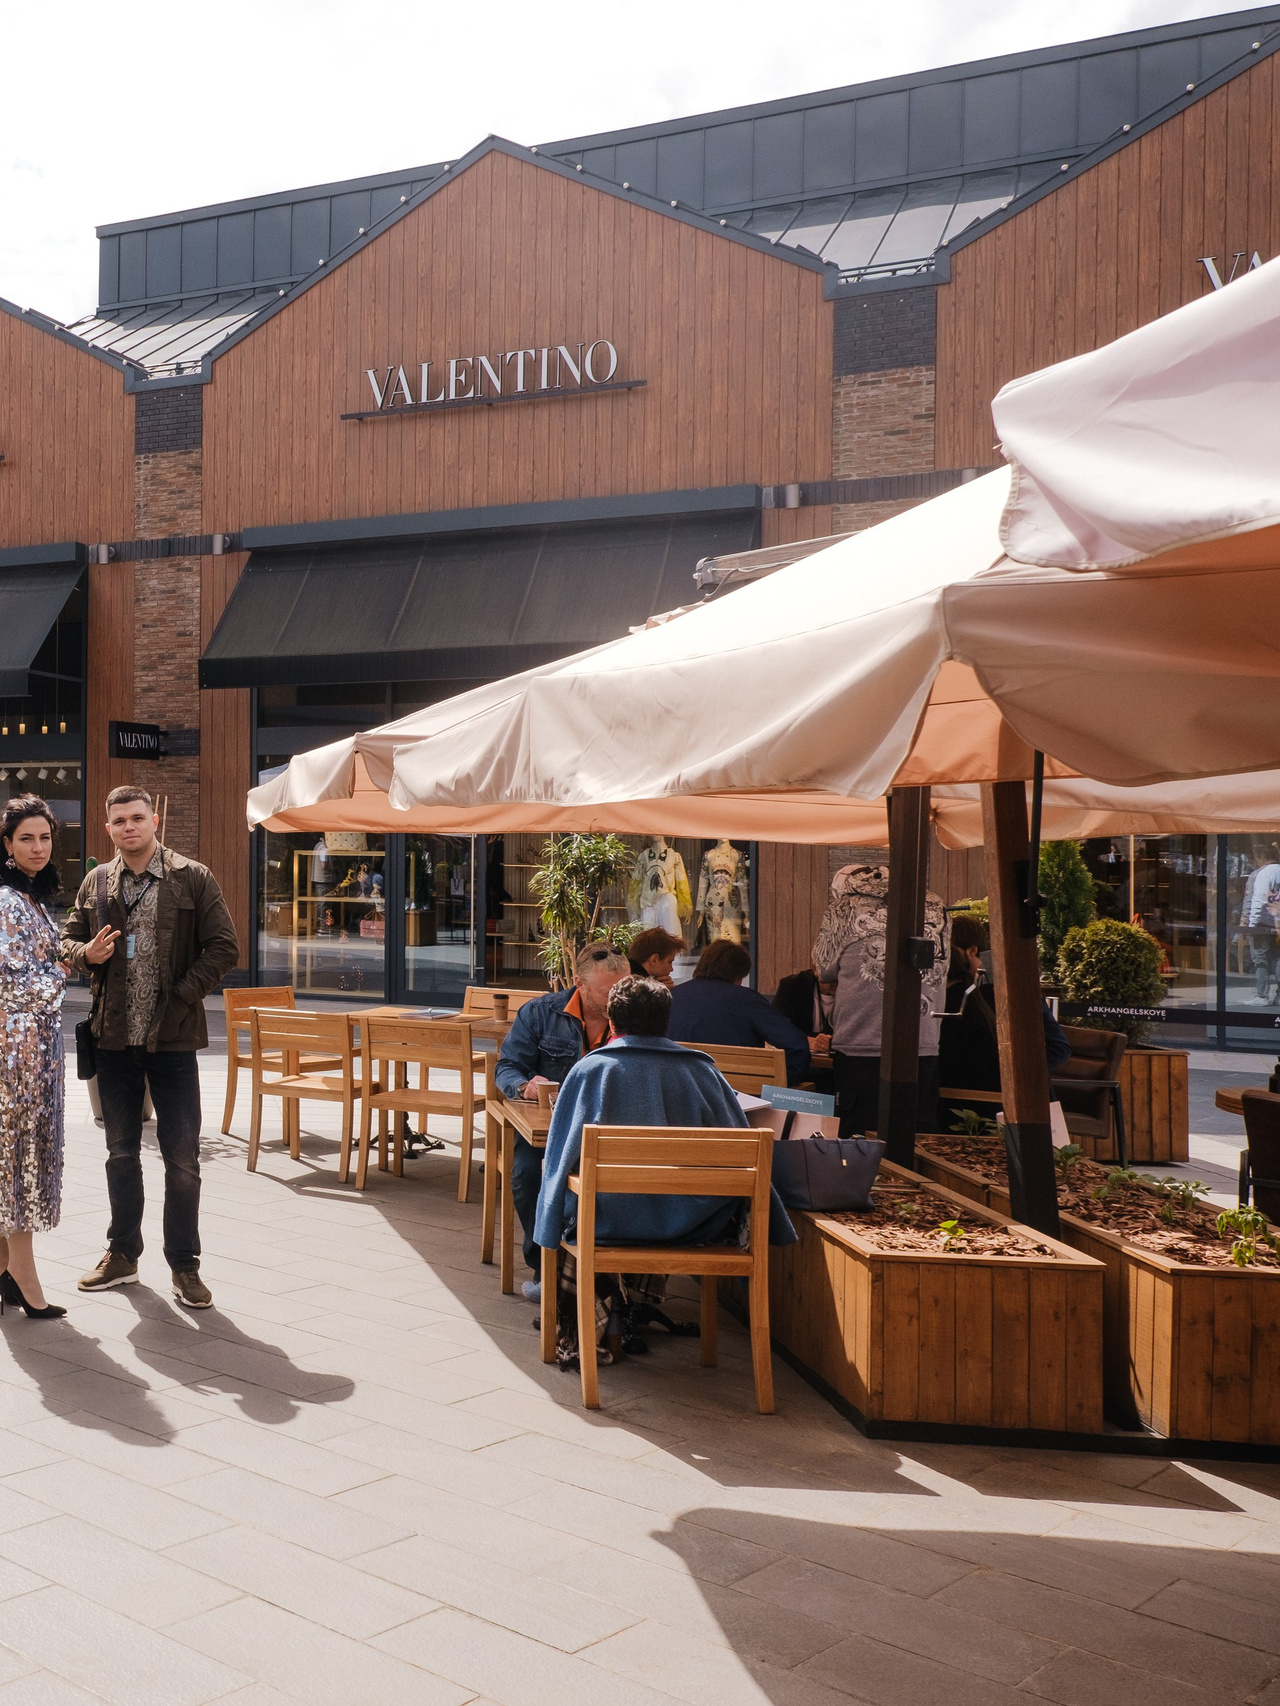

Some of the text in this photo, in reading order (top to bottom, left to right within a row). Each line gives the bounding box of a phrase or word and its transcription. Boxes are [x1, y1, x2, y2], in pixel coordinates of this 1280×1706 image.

[363, 340, 618, 409] VALENTINO
[119, 731, 158, 750] VALENTINO
[1087, 1005, 1166, 1017] ARKHANGELSKOYE
